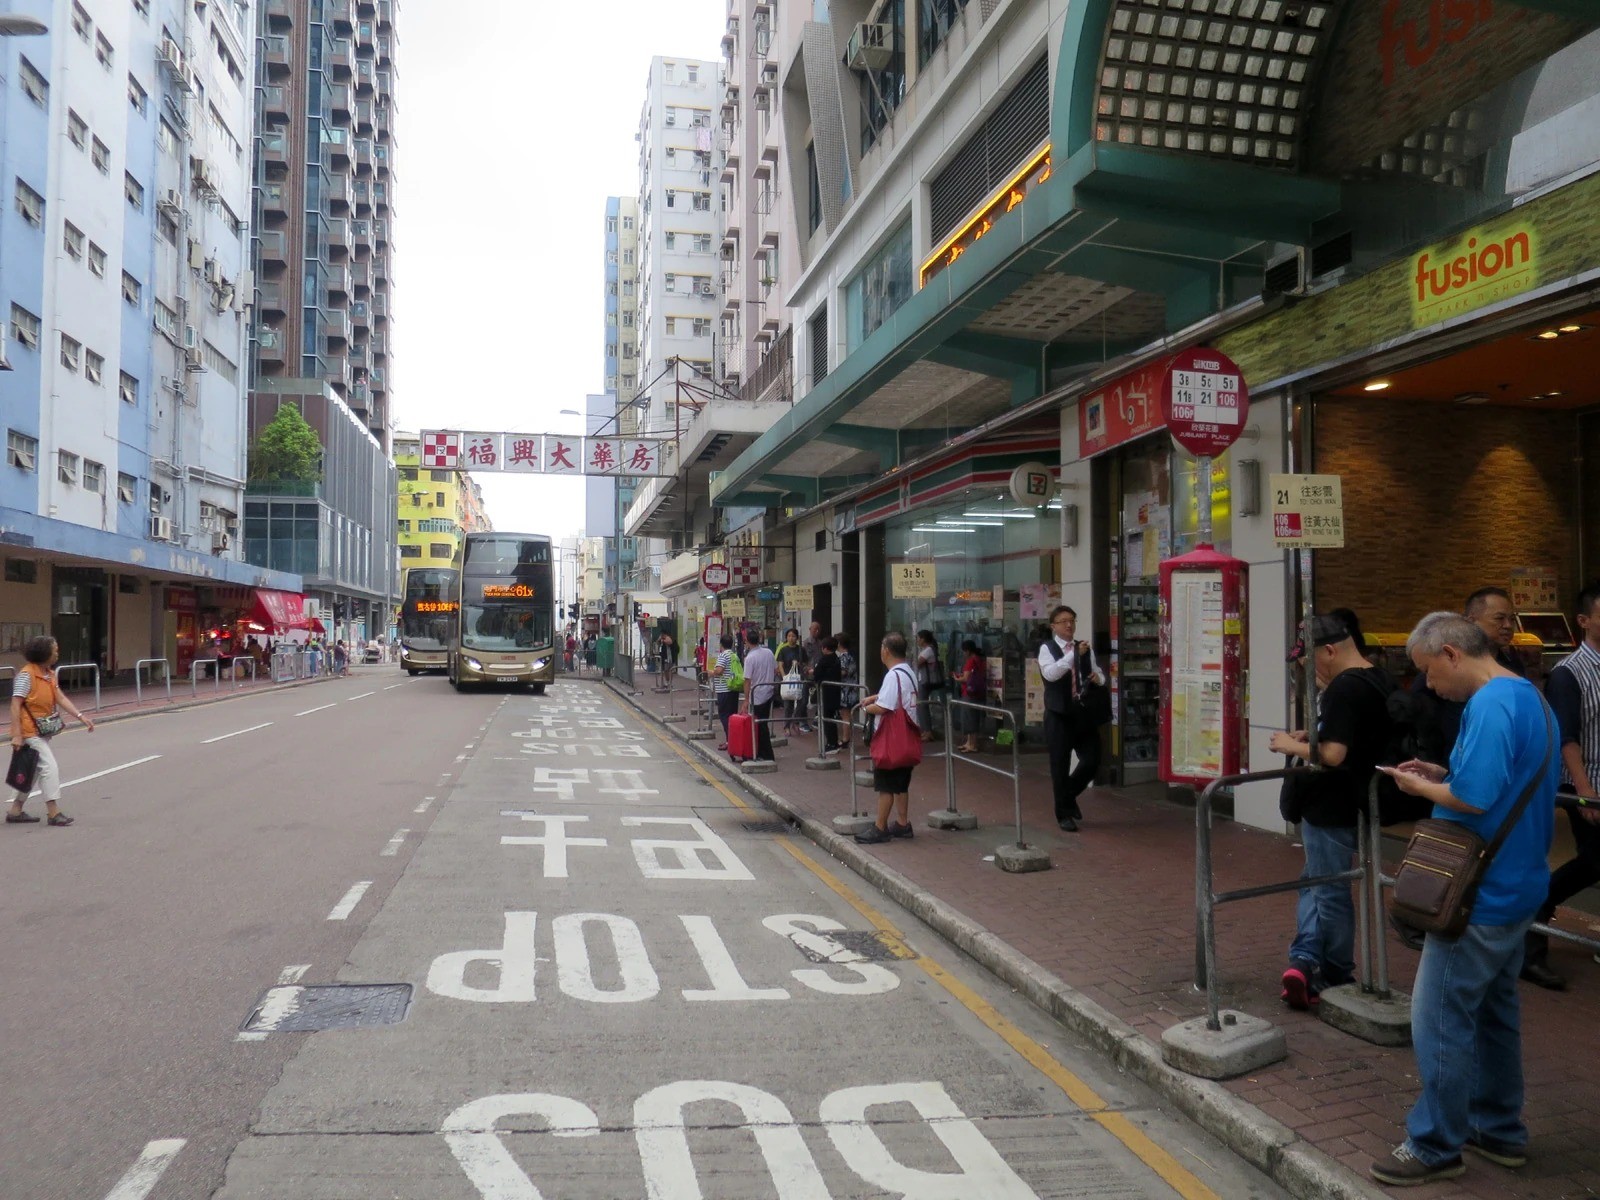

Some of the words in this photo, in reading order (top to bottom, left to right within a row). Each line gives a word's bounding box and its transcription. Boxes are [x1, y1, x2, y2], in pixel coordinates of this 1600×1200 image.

[1415, 231, 1530, 303] fusion
[1437, 299, 1469, 317] PARK
[1493, 276, 1532, 298] SHOP
[1178, 373, 1190, 386] 3B
[1201, 375, 1212, 388] 5C
[1223, 377, 1234, 390] 5D
[1177, 390, 1192, 403] 11B
[1200, 391, 1212, 405] 21
[1218, 393, 1236, 407] 106
[1173, 405, 1194, 420] 106P
[1211, 433, 1230, 441] PLACE
[468, 437, 655, 473] 福興大藥房
[1277, 489, 1289, 505] 21
[1301, 485, 1333, 498] 往彩雲
[1275, 514, 1289, 526] 106
[1304, 515, 1340, 528] 往黃大仙
[511, 726, 645, 741] STOP
[520, 742, 652, 758] BUS
[533, 767, 660, 801] 站
[500, 815, 756, 881] 巴士
[425, 910, 902, 1004] STOP
